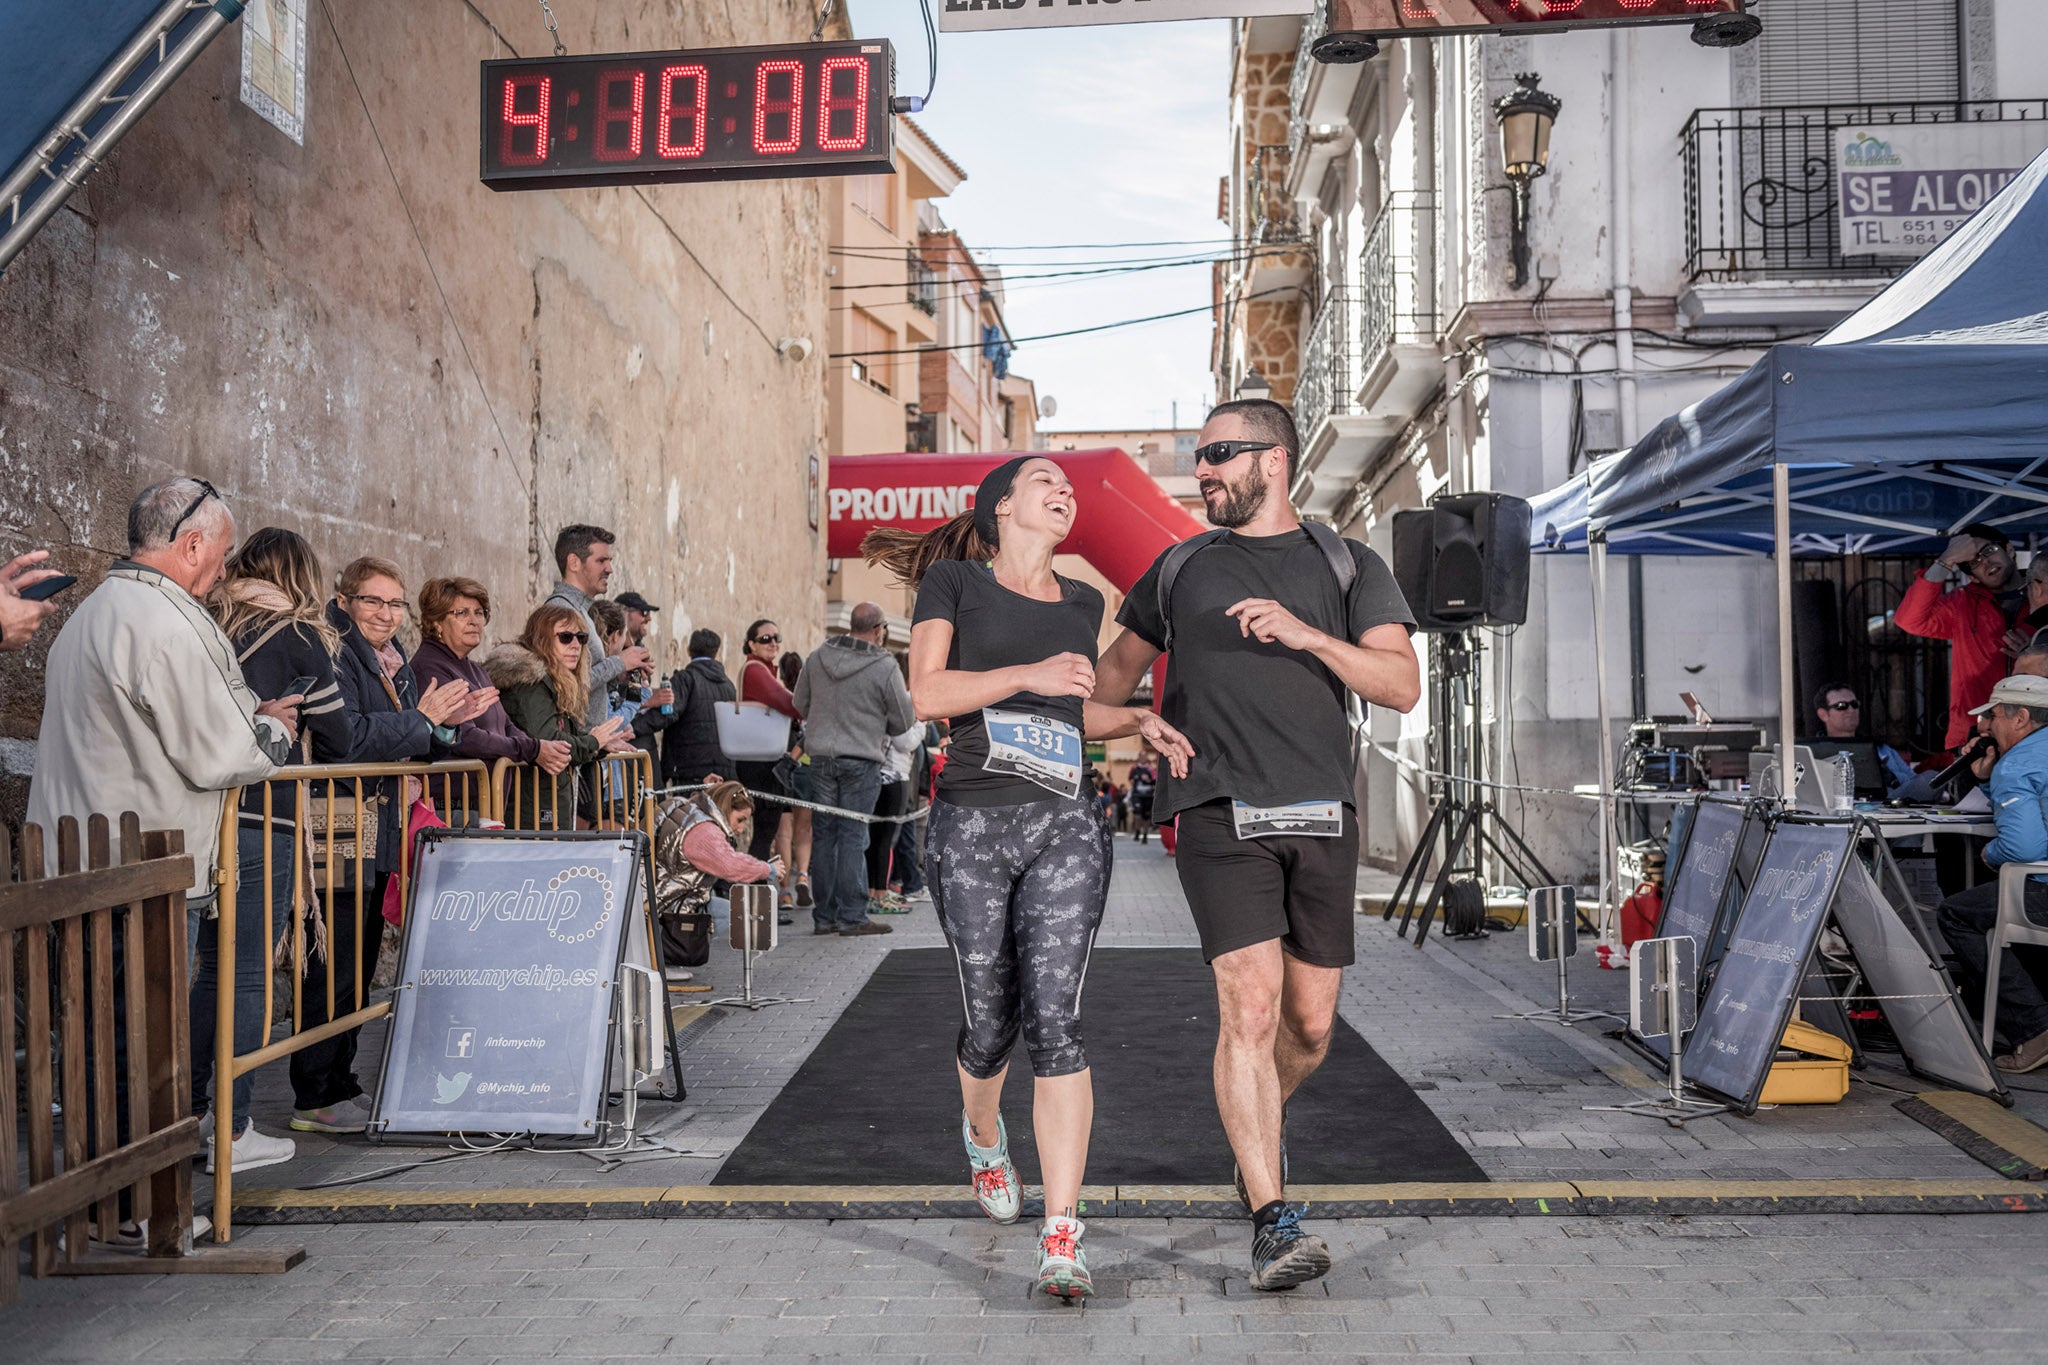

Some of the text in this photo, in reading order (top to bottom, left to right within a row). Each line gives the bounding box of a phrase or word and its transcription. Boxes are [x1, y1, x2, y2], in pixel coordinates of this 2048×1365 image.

[1849, 173, 2015, 213] SE ALQU
[1902, 219, 1964, 232] 651 9
[1903, 234, 1937, 245] 964
[828, 485, 980, 521] PROVINC
[1012, 725, 1065, 756] 1331
[431, 879, 582, 932] mychip
[419, 964, 597, 991] www.mychip.es
[484, 1033, 547, 1050] /infomychip
[476, 1081, 551, 1097] @Mychip_Info
